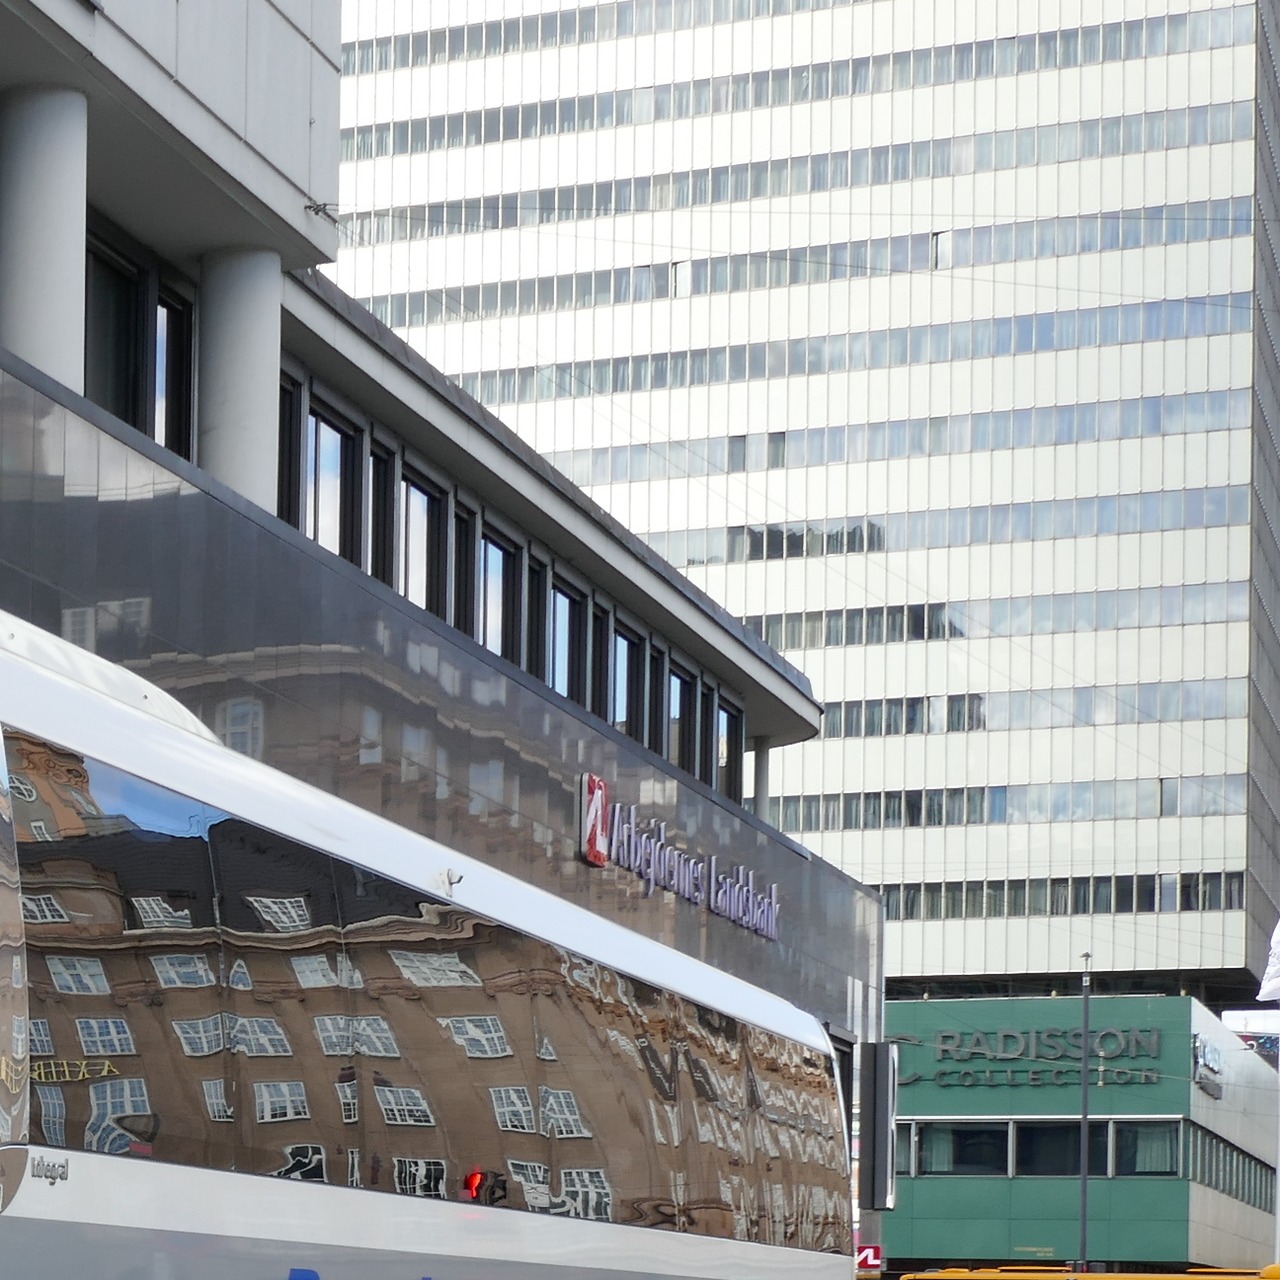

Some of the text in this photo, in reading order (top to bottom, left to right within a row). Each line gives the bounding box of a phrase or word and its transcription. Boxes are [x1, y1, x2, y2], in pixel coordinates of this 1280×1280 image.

[610, 802, 781, 942] Arbejdernes Landsbank
[935, 1027, 1161, 1062] RADISSON
[934, 1067, 1160, 1087] COLLECON
